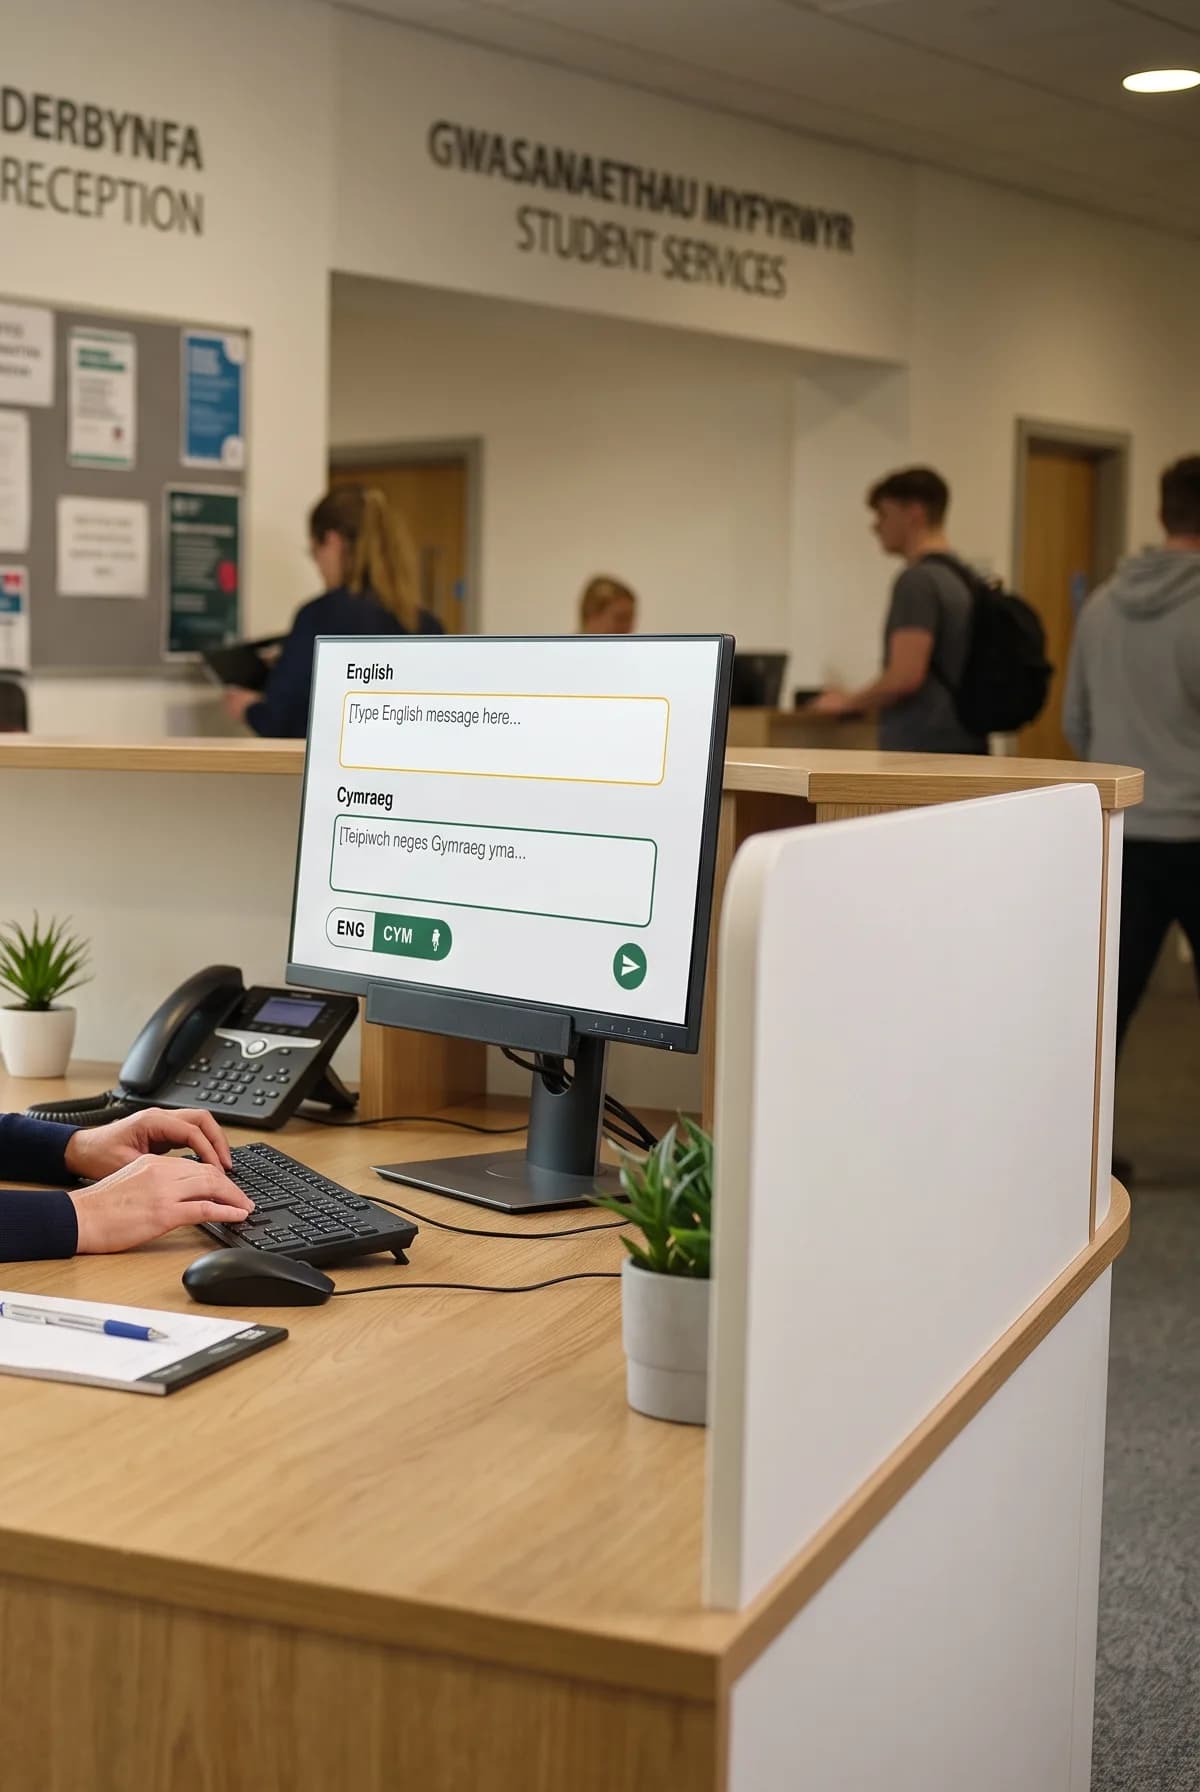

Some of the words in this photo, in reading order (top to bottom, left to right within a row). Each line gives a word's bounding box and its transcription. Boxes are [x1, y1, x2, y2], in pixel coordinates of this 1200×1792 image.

[0, 86, 204, 170] DERBYNFA
[428, 120, 698, 219] GWASANAETHAU
[0, 157, 204, 236] RECEPTION
[515, 205, 659, 273] STUDENT
[662, 235, 787, 299] SERVICES
[346, 663, 394, 684] English
[382, 704, 423, 725] English
[426, 710, 479, 727] message
[482, 707, 521, 725] here...
[337, 786, 393, 811] Cymraeg
[393, 833, 428, 853] neges
[431, 834, 486, 860] Gymraeg
[488, 845, 526, 860] yma...
[337, 919, 365, 938] ENG
[383, 925, 413, 944] CYM
